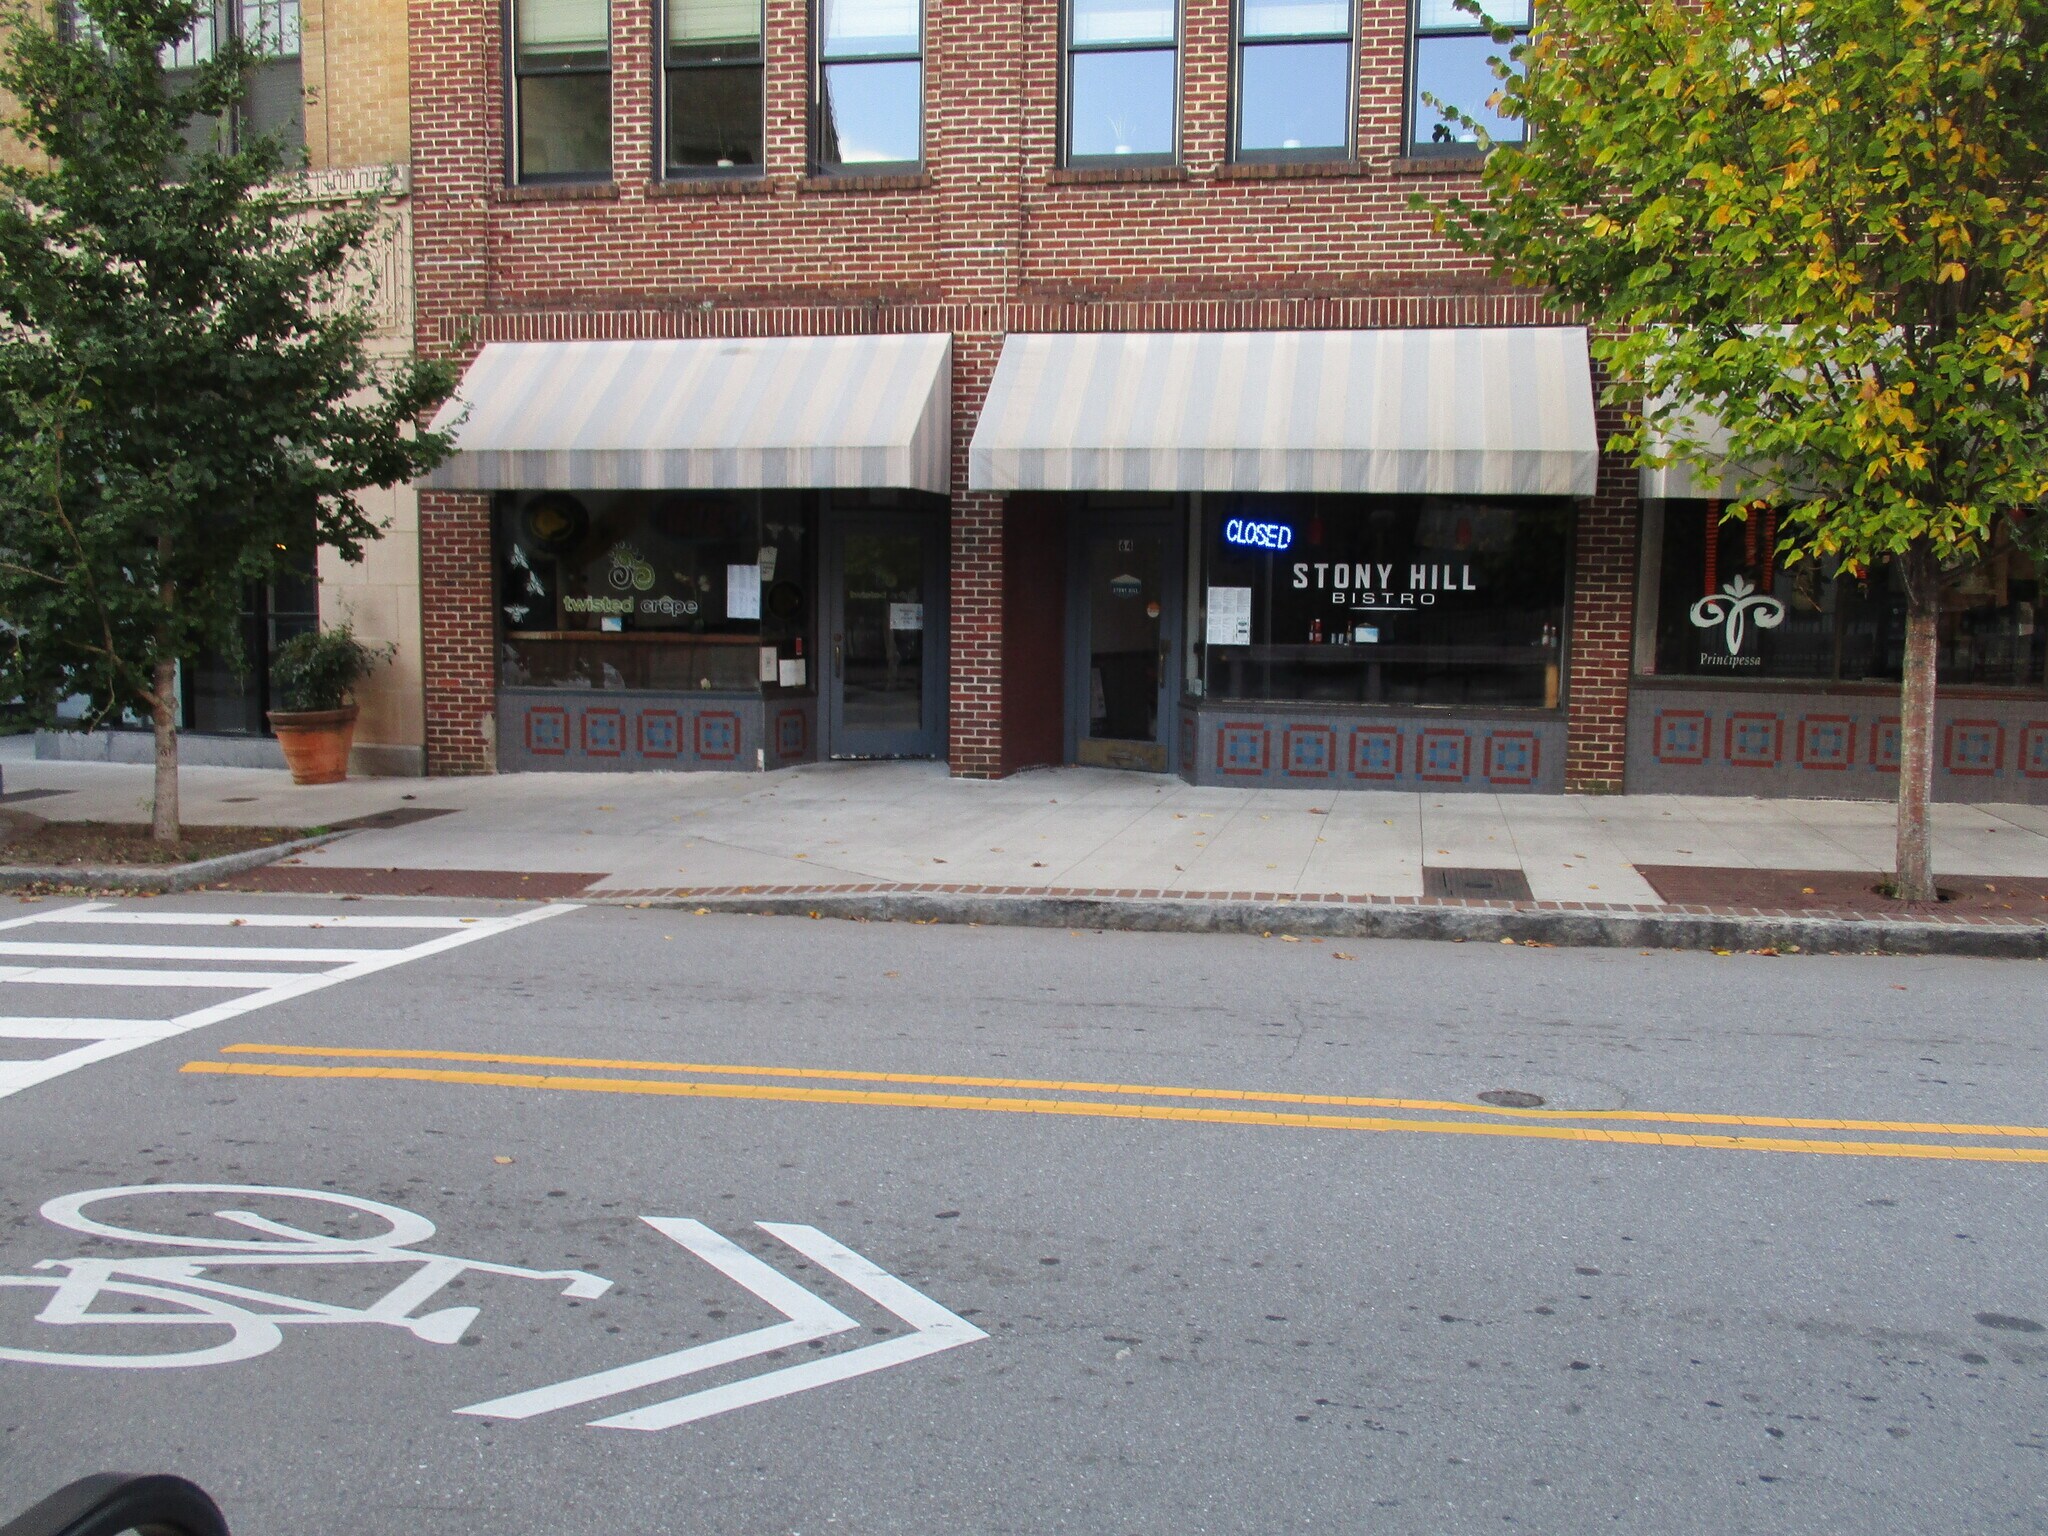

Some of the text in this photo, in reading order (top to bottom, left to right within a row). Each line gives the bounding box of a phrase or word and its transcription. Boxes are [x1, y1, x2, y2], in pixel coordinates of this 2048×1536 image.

[1226, 519, 1292, 549] CLOSED
[1293, 562, 1477, 591] STONY HILL
[563, 595, 698, 617] twisted crêpe
[1332, 592, 1436, 605] BISTRO
[1700, 652, 1760, 669] Principessa
